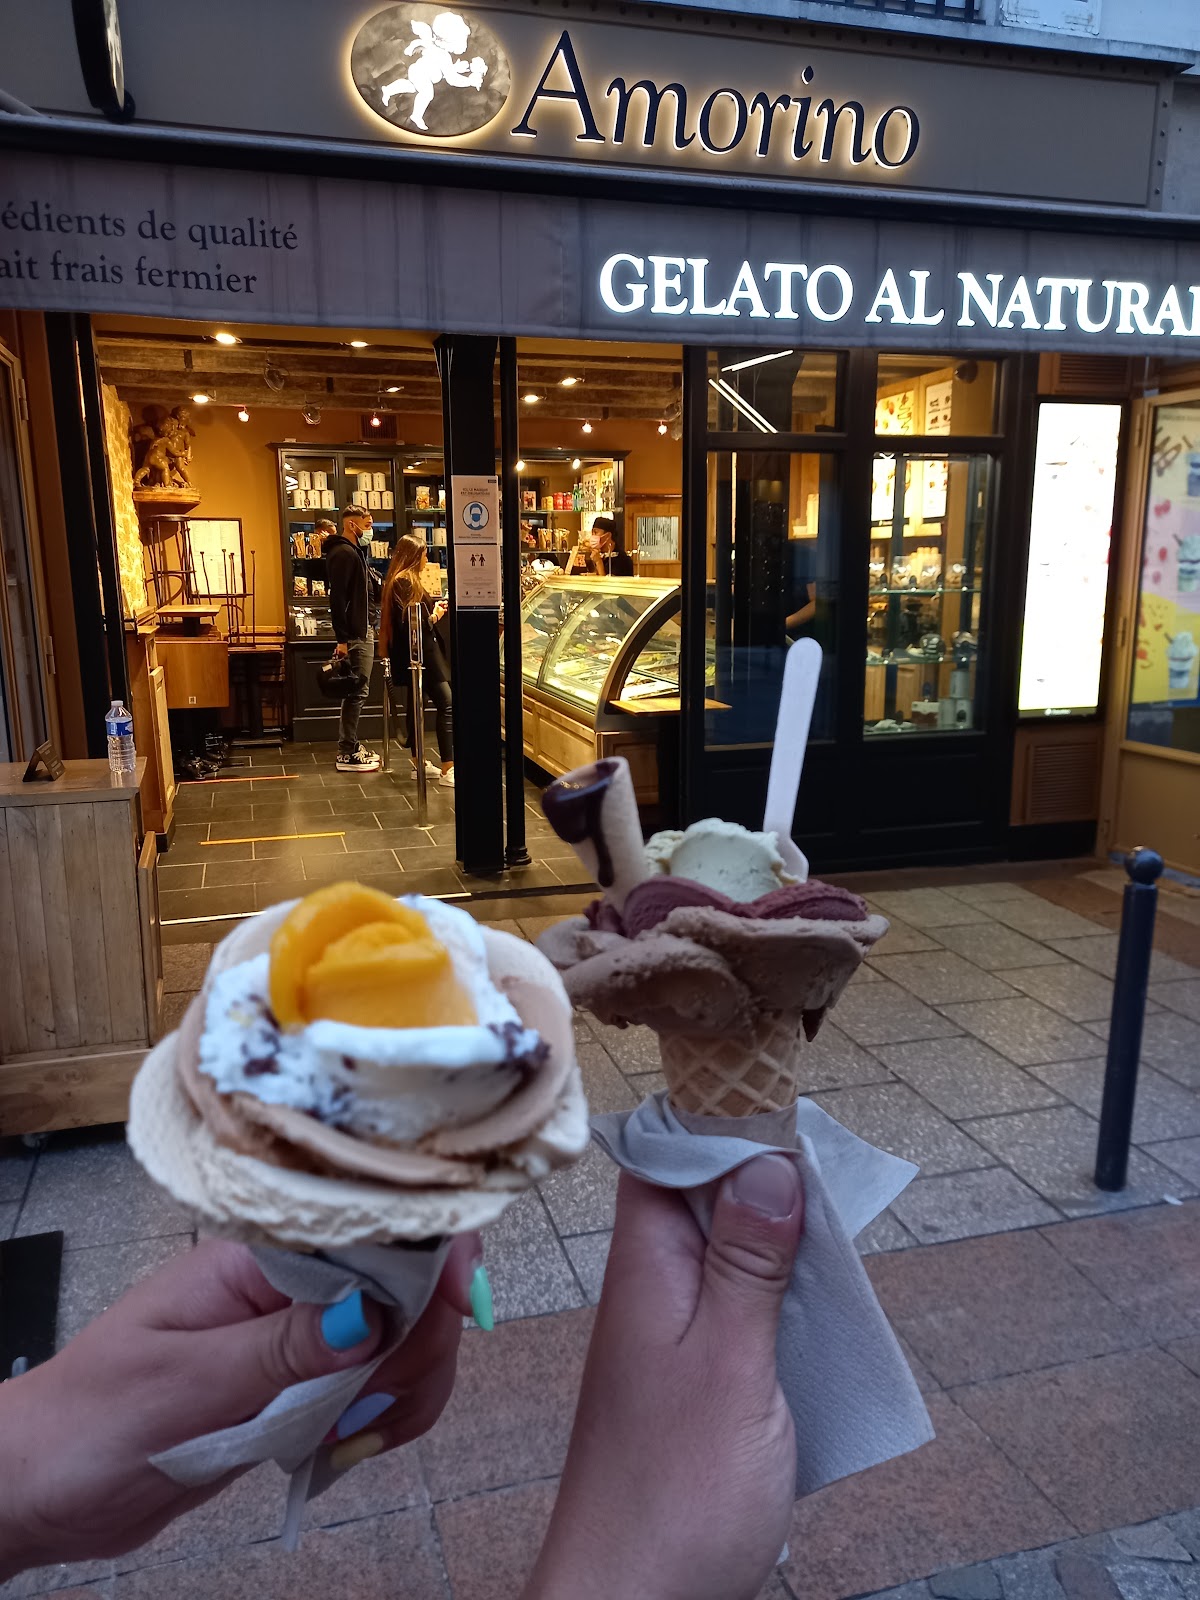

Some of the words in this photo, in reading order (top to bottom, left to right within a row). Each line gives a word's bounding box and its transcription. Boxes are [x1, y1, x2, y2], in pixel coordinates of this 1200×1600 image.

[510, 30, 920, 169] Amorino
[1, 201, 126, 237] édients
[138, 210, 177, 241] de
[188, 217, 299, 251] qualité
[0, 250, 40, 281] ait
[50, 250, 124, 285] frais
[135, 256, 258, 294] fermier
[598, 253, 854, 322] GELATO
[865, 268, 944, 326] AL
